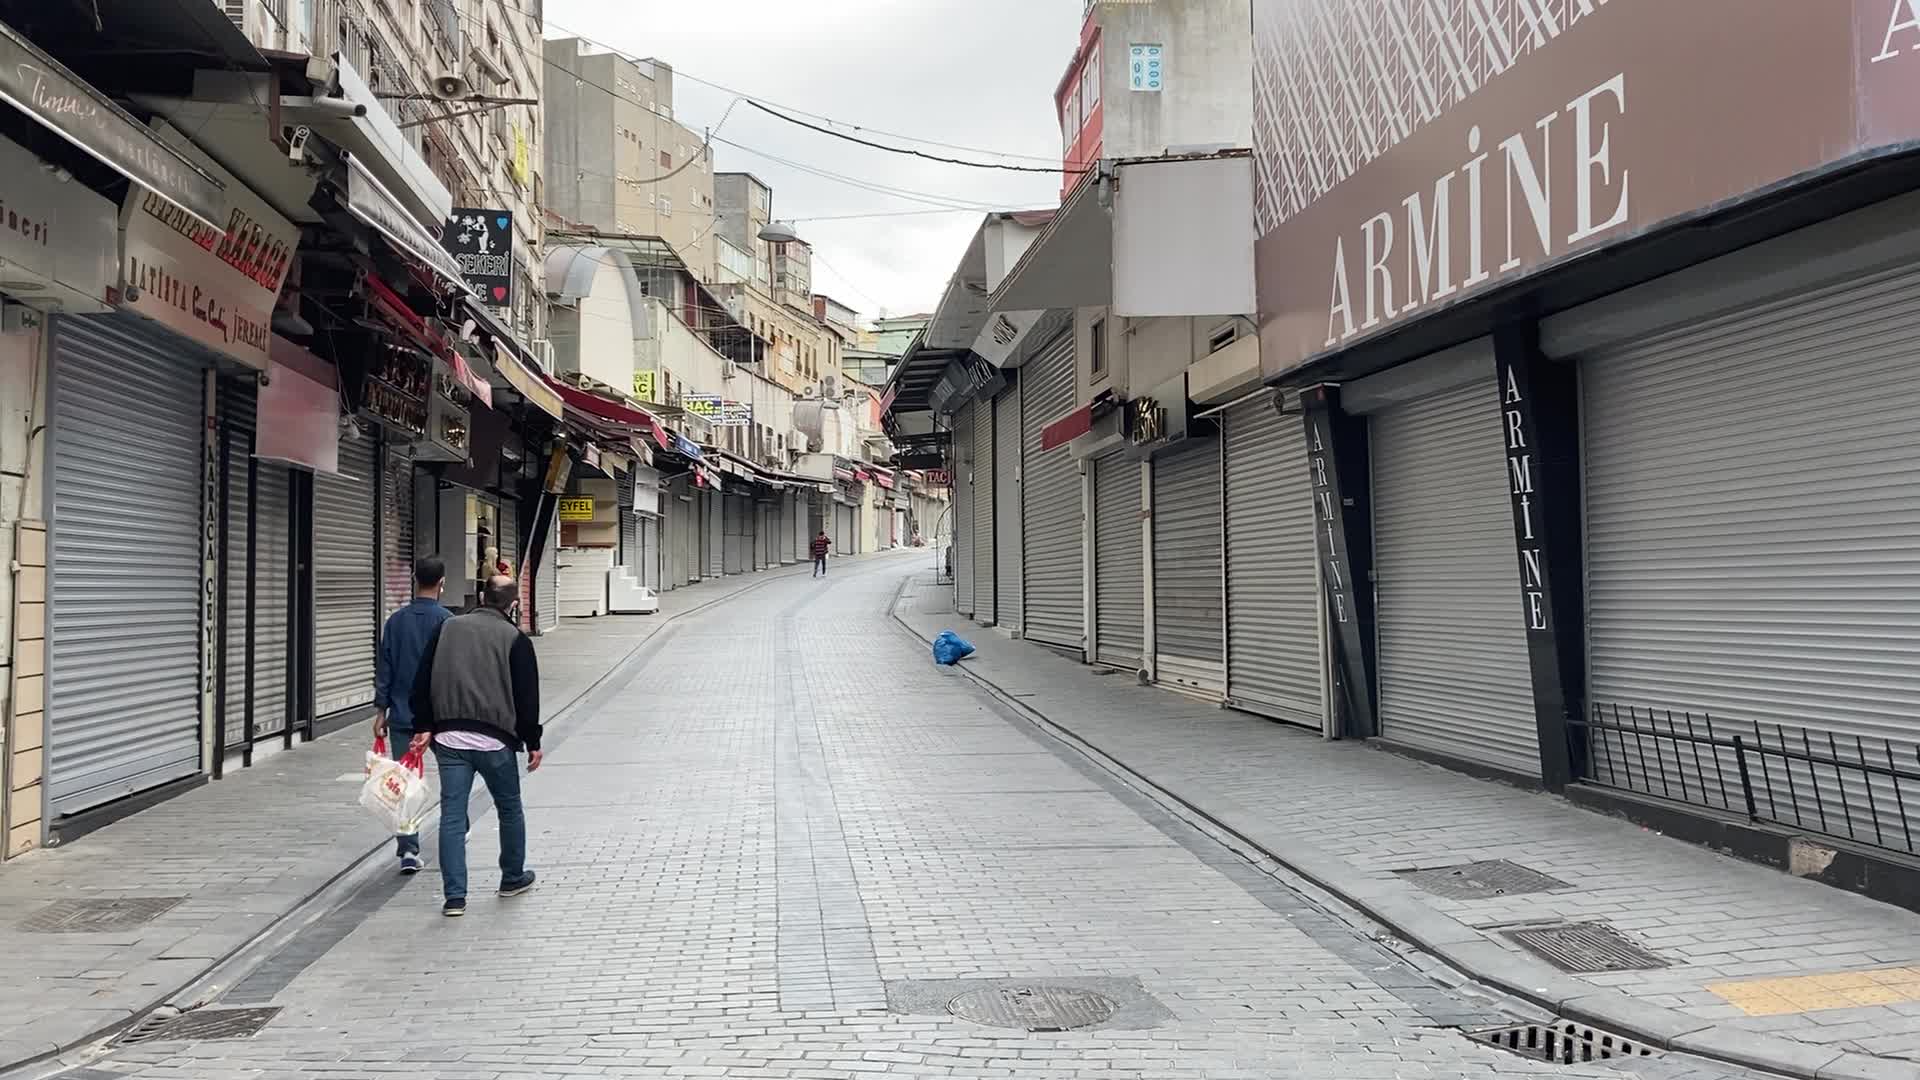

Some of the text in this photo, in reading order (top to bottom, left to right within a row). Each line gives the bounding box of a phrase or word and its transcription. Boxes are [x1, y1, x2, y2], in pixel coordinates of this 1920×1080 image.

[1324, 72, 1628, 347] ARMİNE
[560, 501, 591, 511] EYFEL
[1313, 422, 1348, 623] ARMİNE
[1505, 364, 1547, 630] ARMİNE
